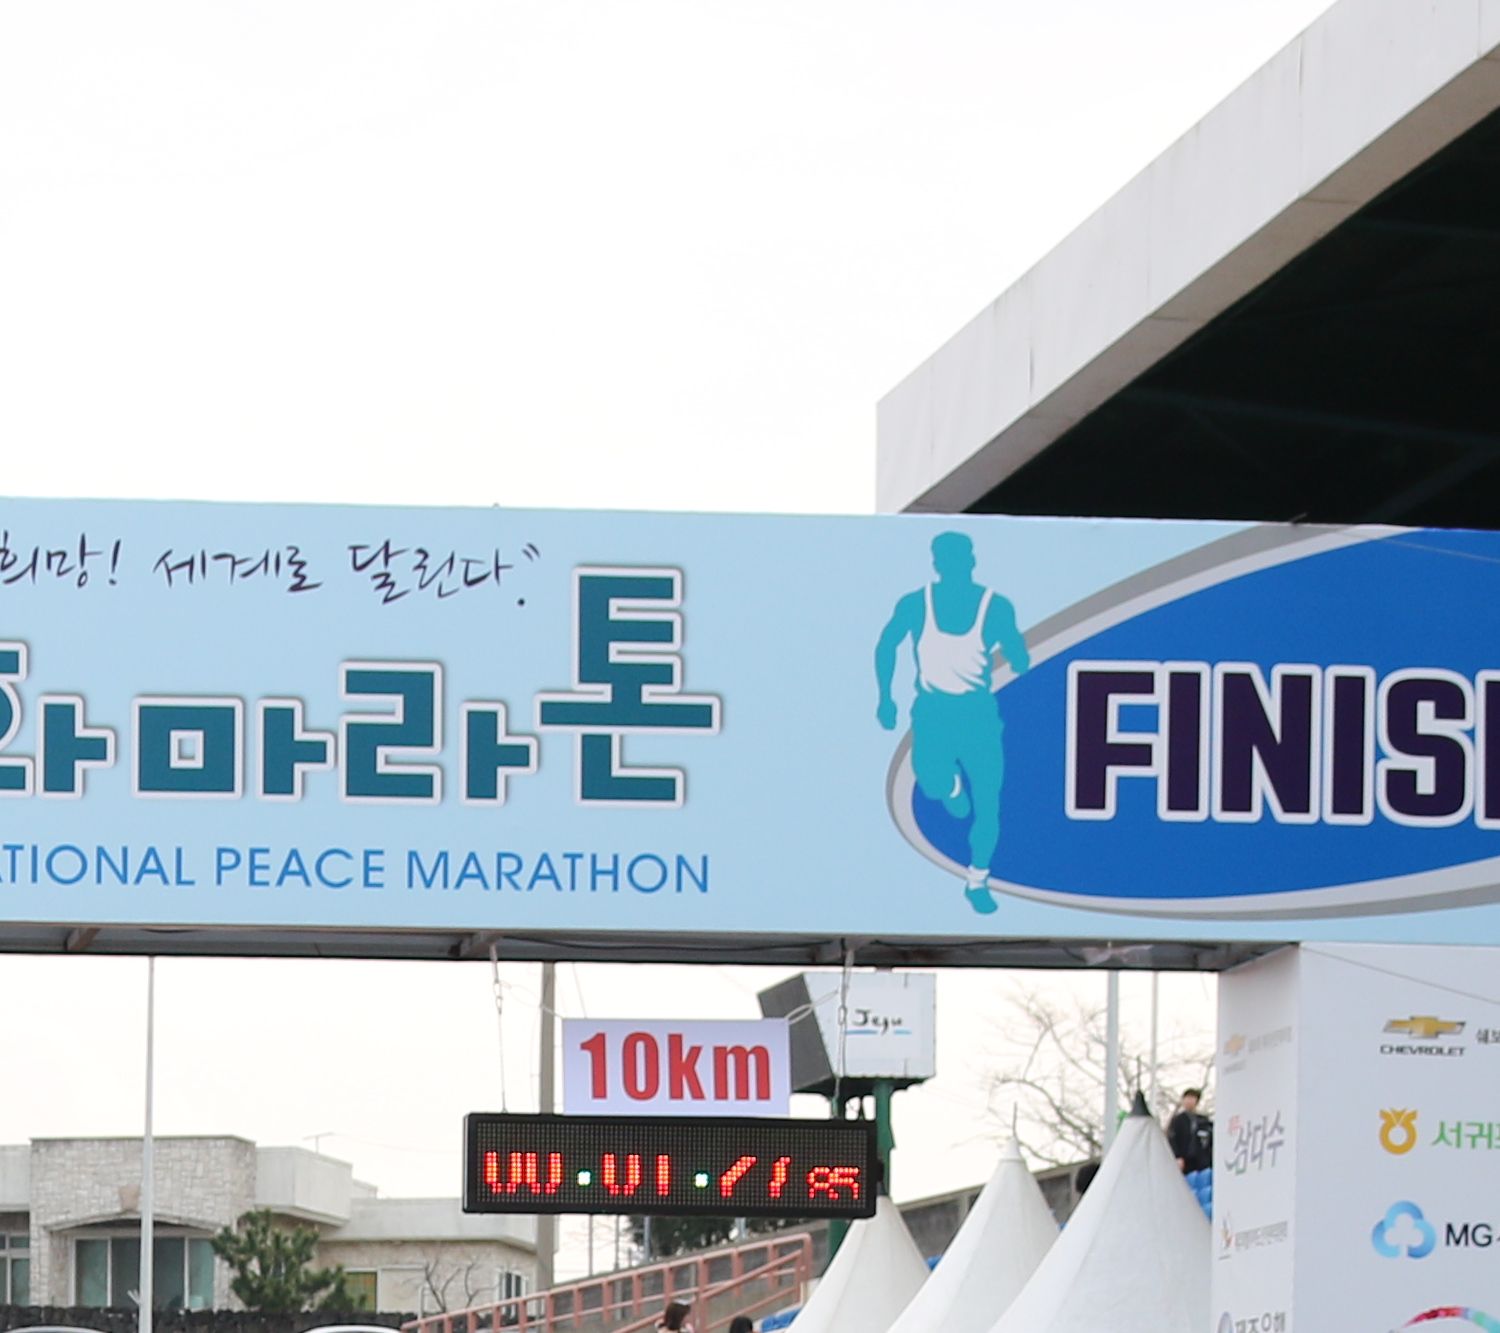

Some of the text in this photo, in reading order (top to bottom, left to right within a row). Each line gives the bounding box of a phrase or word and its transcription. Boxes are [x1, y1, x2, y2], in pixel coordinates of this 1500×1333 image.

[151, 540, 324, 593] 세계로
[213, 845, 387, 891] PEACE
[405, 848, 711, 894] MARATHON
[579, 1031, 772, 1101] 10km
[1379, 1044, 1467, 1057] CHEVROLET
